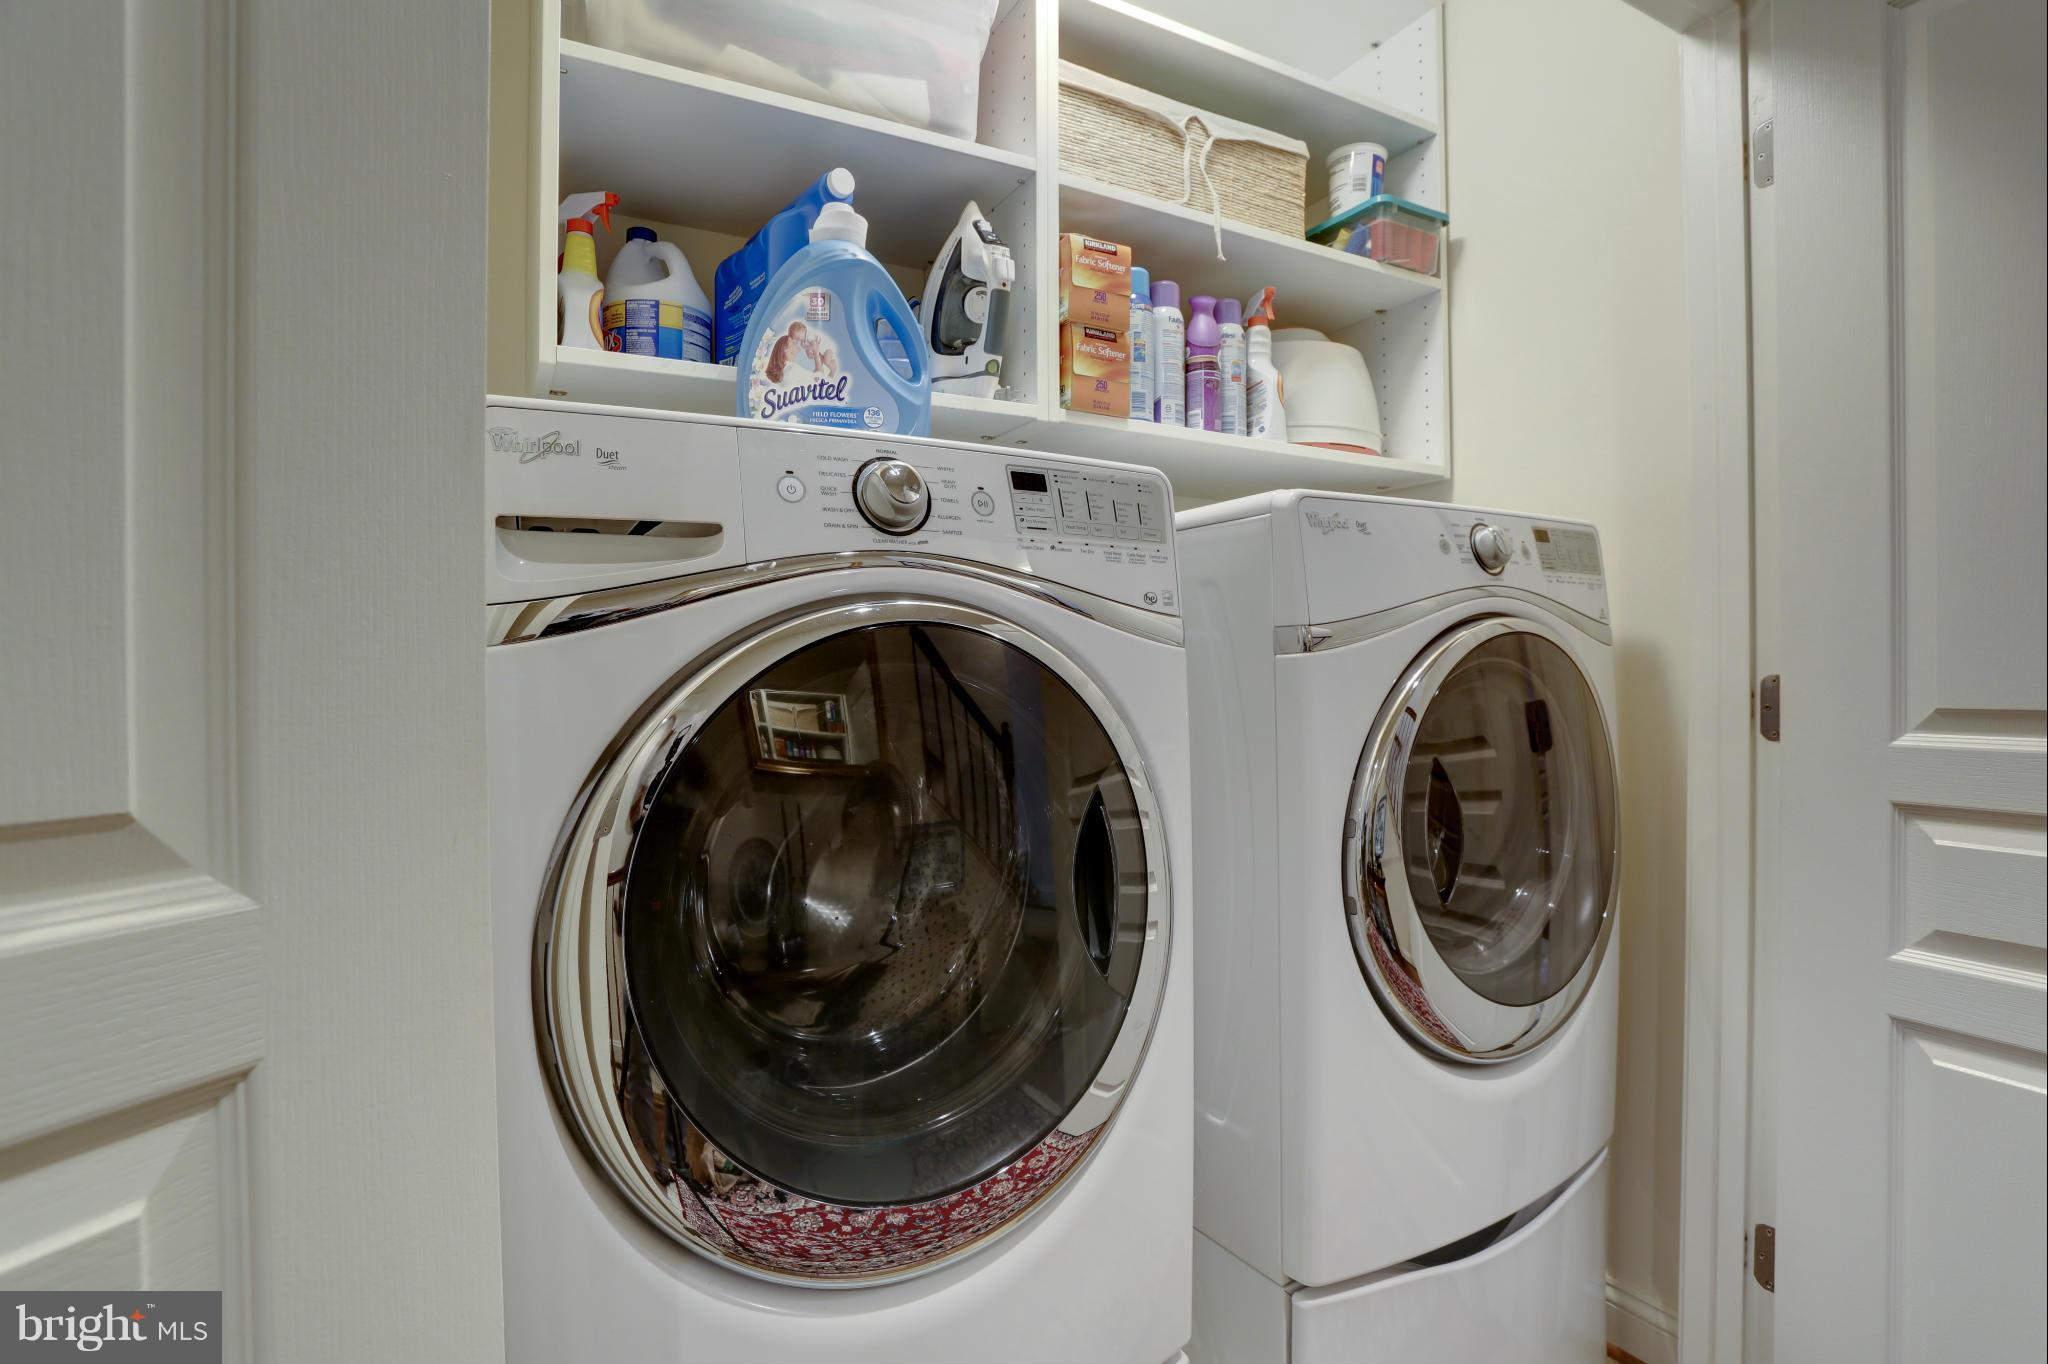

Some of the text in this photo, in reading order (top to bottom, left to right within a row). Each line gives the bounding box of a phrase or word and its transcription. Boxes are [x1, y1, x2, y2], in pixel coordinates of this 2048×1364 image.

[1084, 240, 1116, 252] KIRKLAND
[1075, 254, 1096, 266] Fabric
[1097, 259, 1126, 273] Softener
[1094, 290, 1107, 302] 250
[1076, 343, 1126, 359] Fabric Softener
[1095, 379, 1108, 391] 250
[761, 375, 848, 419] Suavitel
[487, 427, 581, 463] Whirlpool
[596, 447, 619, 460] Duet
